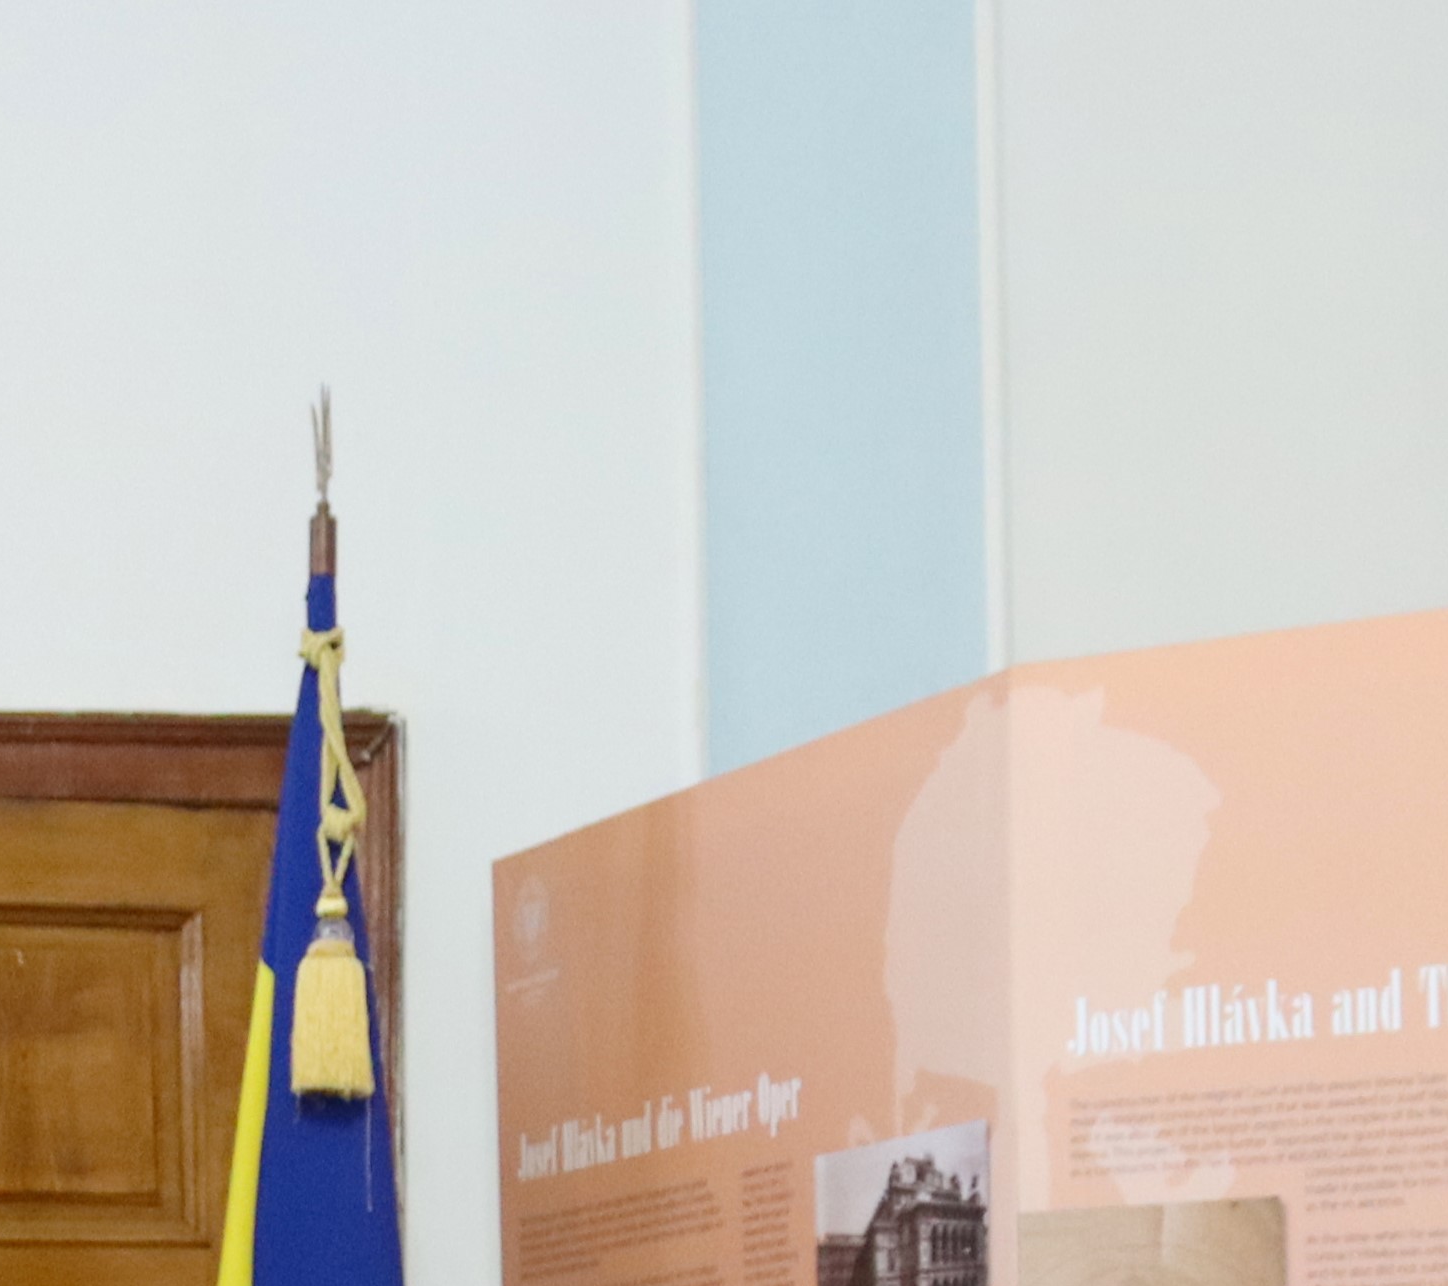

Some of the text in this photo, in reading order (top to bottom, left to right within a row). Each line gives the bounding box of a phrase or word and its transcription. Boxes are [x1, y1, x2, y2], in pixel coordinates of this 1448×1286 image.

[1066, 989, 1169, 1057] Josef
[1182, 978, 1315, 1048] Hlávka
[1331, 967, 1403, 1037] and
[517, 1125, 557, 1181] Josef
[621, 1101, 652, 1159] und
[657, 1095, 684, 1150] die
[688, 1085, 752, 1142] Wiener
[757, 1072, 802, 1138] Oper
